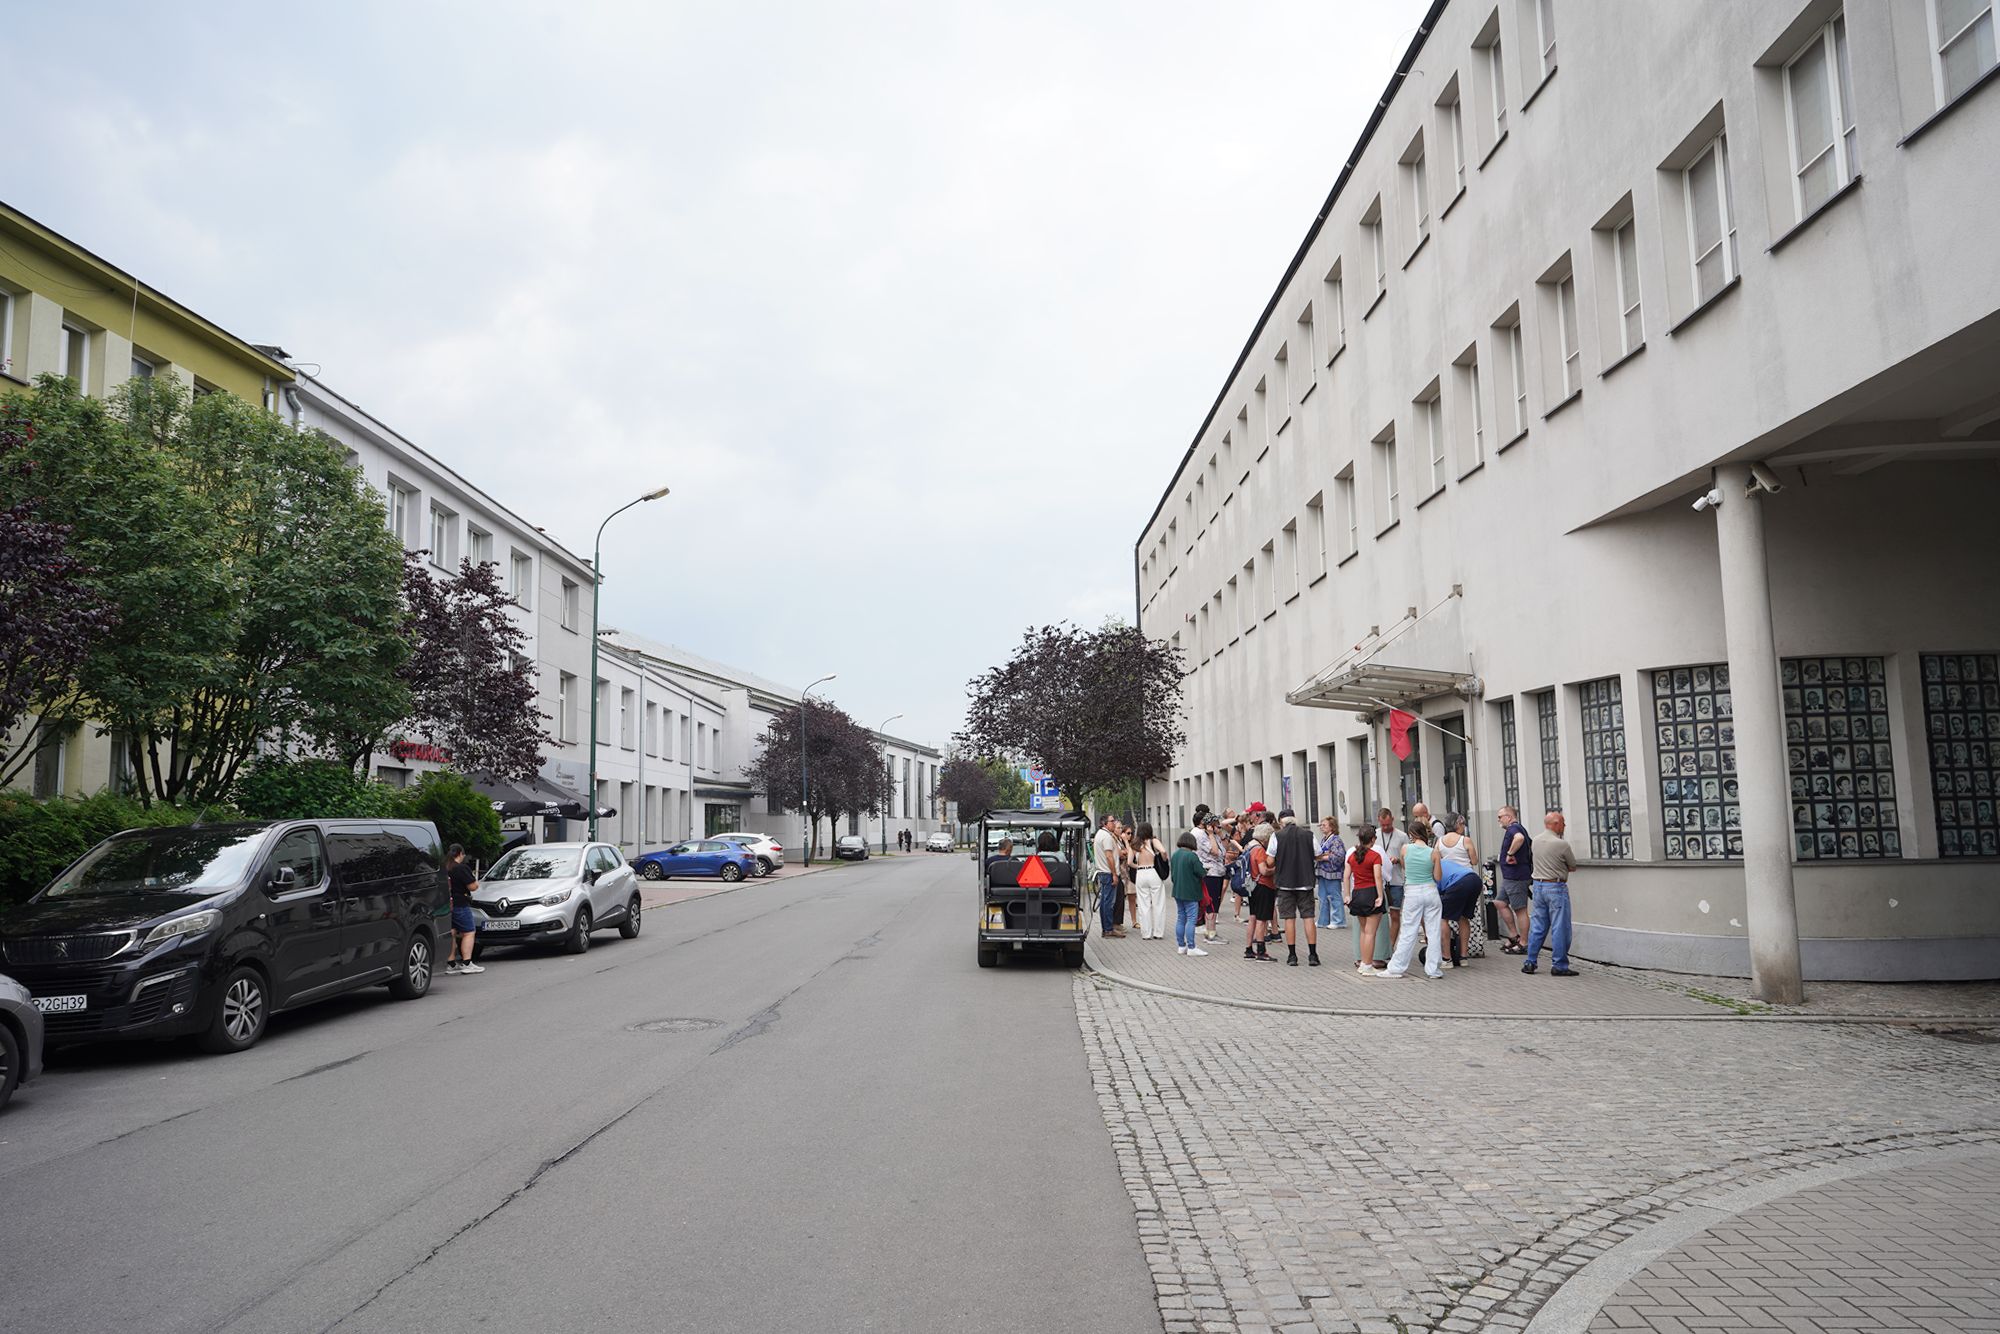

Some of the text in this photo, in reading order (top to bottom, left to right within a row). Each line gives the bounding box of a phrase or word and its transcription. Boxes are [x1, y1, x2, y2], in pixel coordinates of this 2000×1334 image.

[1044, 780, 1055, 795] P
[1033, 795, 1042, 807] P
[45, 996, 85, 1011] 2GH39
